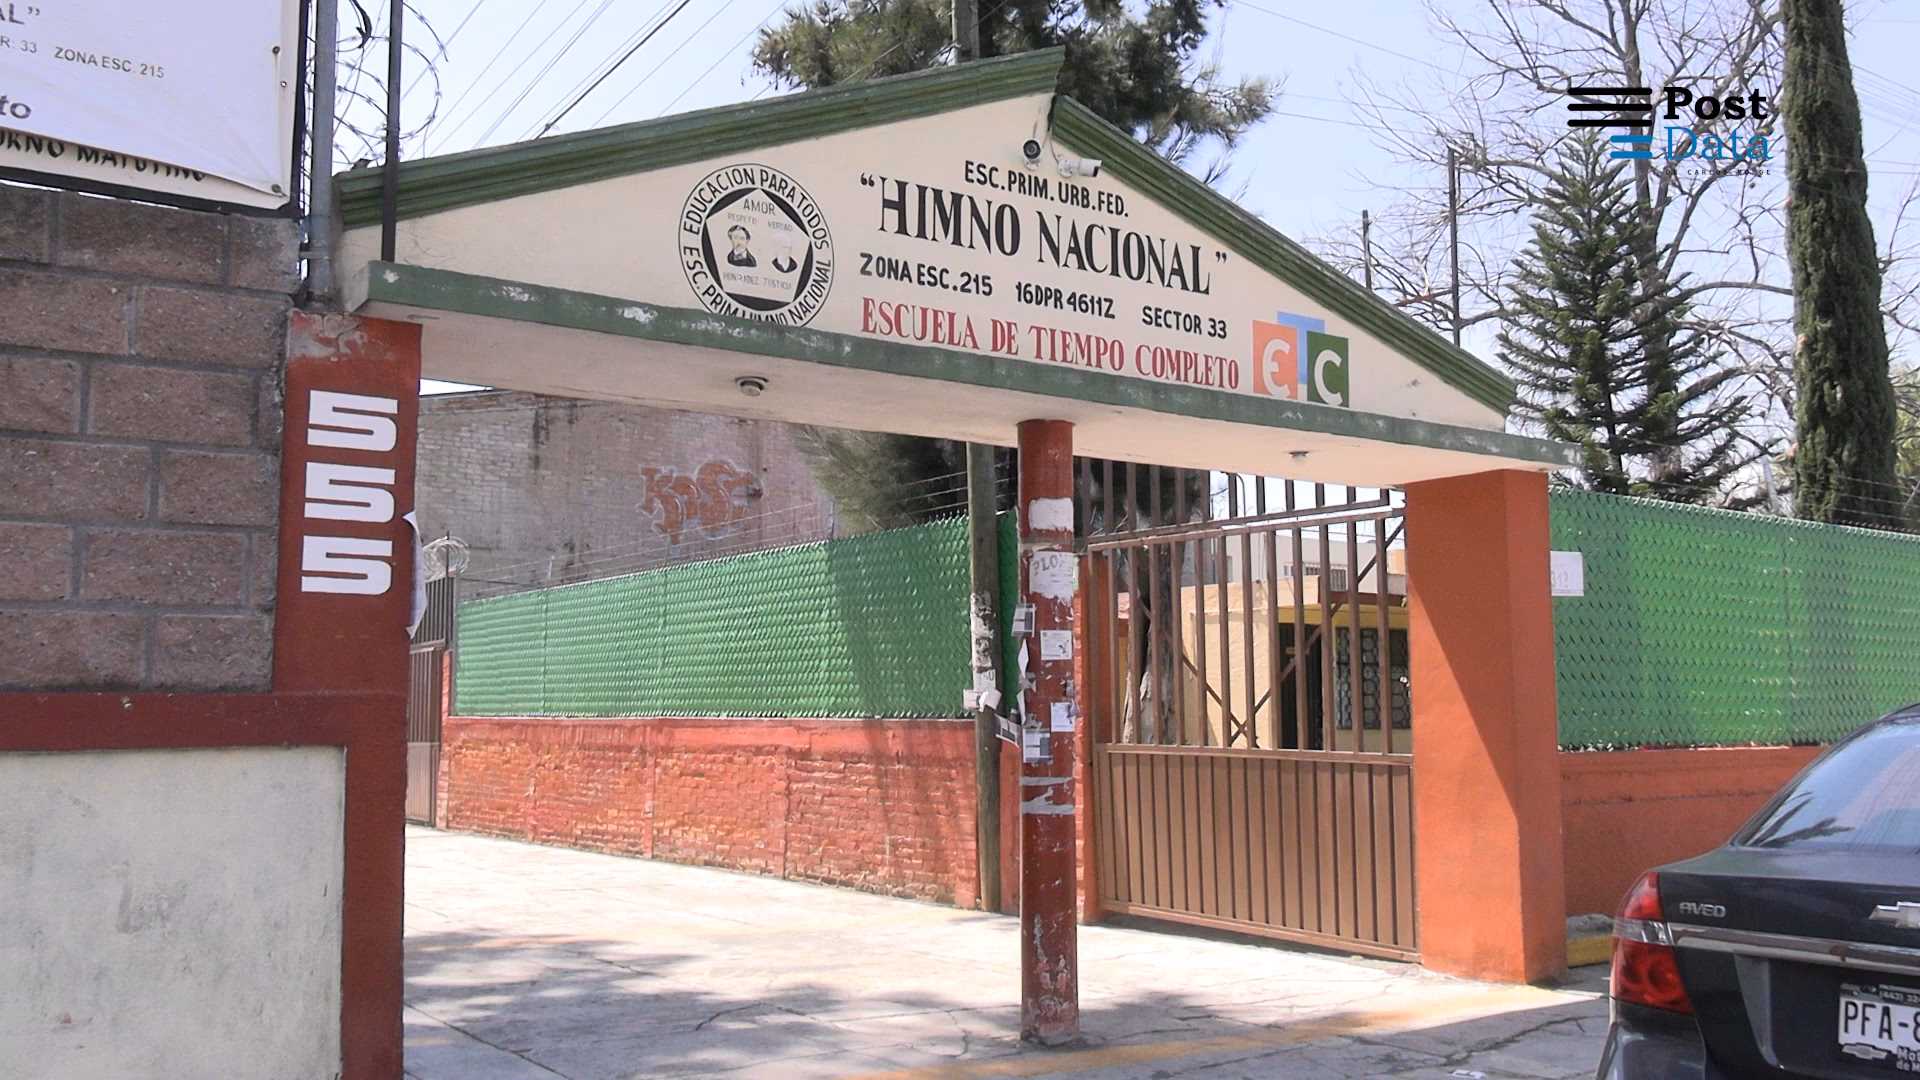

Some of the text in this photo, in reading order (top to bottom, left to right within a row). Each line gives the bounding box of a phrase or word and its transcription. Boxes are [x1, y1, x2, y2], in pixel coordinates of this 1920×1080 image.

[21, 40, 37, 53] 33
[55, 47, 98, 67] ZONA
[102, 57, 136, 73] ESC.
[140, 63, 164, 78] 215
[684, 168, 830, 250] EDUCACION PARA TODOS
[743, 198, 776, 216] AMOR
[860, 172, 1021, 257] “HIMNO
[788, 259, 831, 325] NACIONAL
[860, 252, 912, 285] ZONA
[1141, 305, 1203, 335] SECTOR
[1206, 317, 1228, 340] 33
[861, 296, 1240, 390] ESCUELA DE TIEMPO COMPLETO
